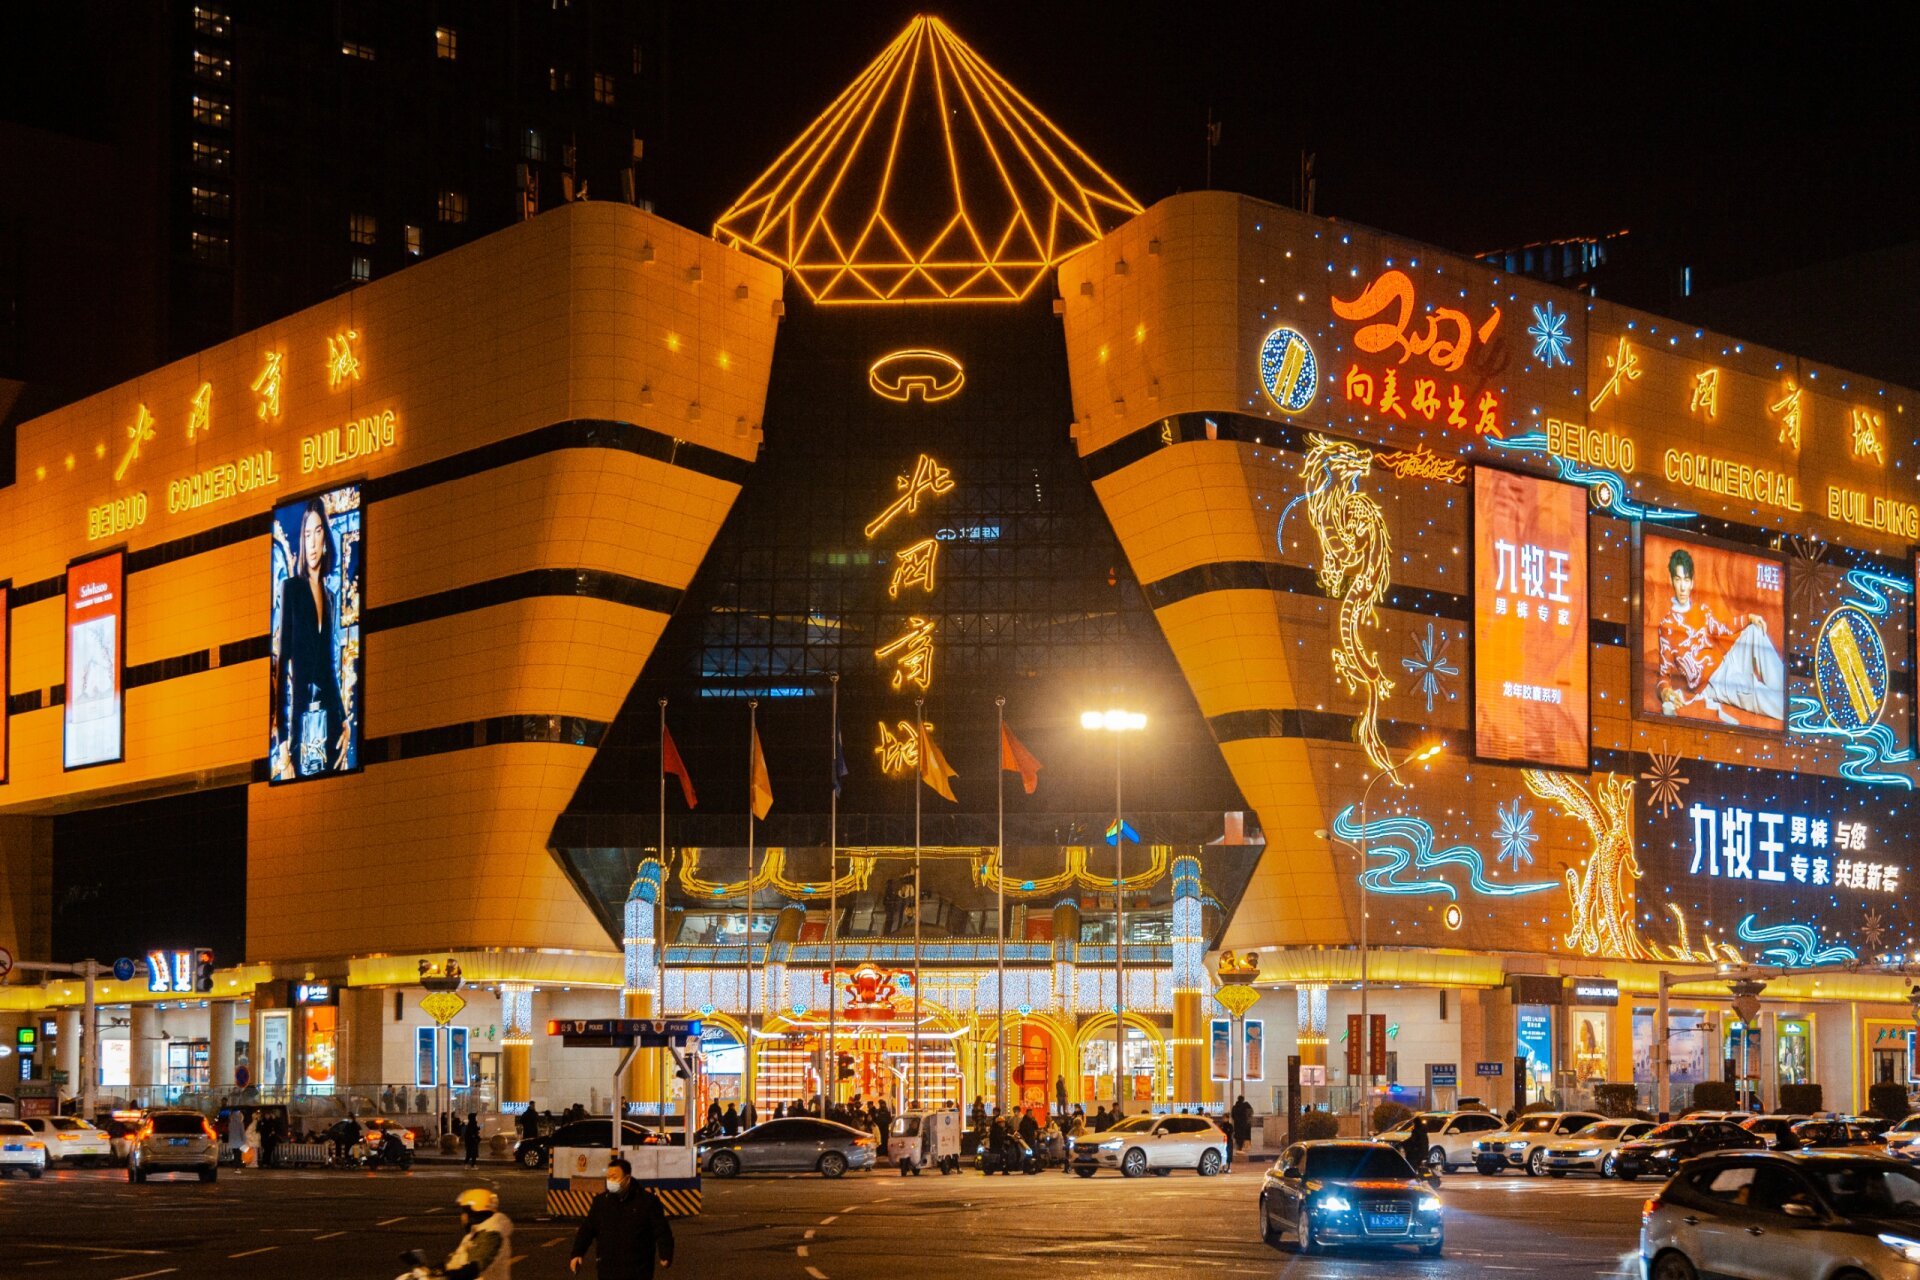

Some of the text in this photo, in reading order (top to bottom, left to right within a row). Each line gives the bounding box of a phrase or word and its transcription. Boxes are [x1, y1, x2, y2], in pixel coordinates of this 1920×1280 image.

[1346, 363, 1503, 439] 向美好出发
[88, 409, 396, 540] BEIGUO COMMERCIAL BUILDING
[1547, 419, 1919, 539] BEIGUO COMMERCIAL BUILDING
[1495, 539, 1570, 603] 九牧王
[1757, 564, 1778, 584] 九牧王
[1496, 597, 1569, 625] 男裤专家
[1690, 803, 1786, 882] 九牧王
[1791, 816, 1829, 848] 男裤
[1834, 821, 1869, 850] 与您
[1791, 854, 1829, 885] 专家
[1834, 859, 1900, 892] 共度新春
[633, 1024, 648, 1032] 公安
[670, 1024, 689, 1032] POLICE
